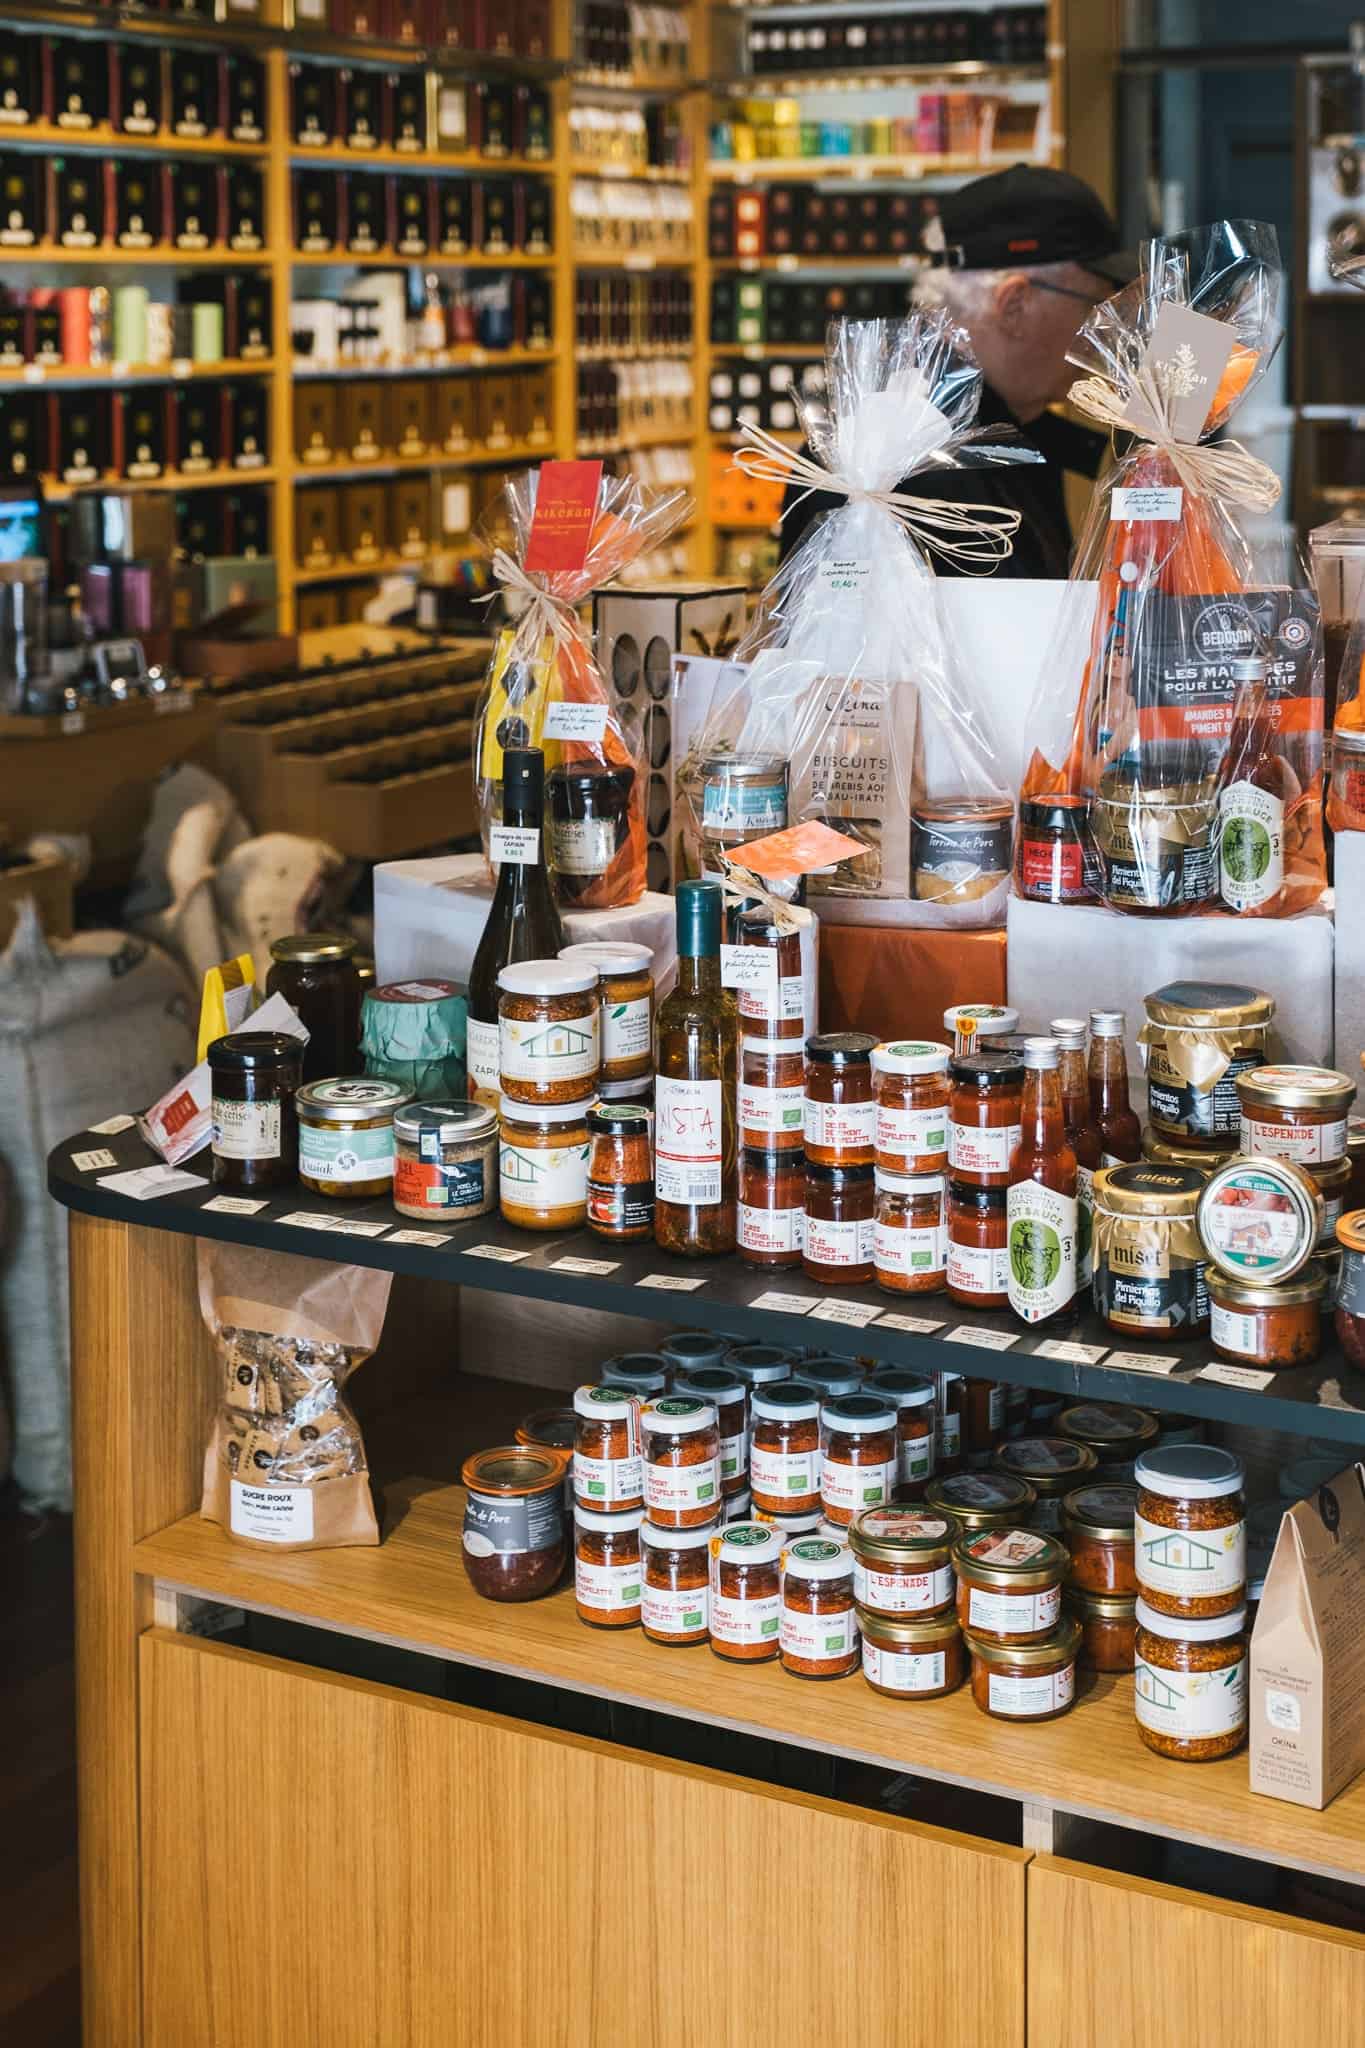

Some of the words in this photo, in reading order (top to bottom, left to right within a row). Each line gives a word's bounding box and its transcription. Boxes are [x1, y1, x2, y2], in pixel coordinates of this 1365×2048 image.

[1164, 668, 1198, 680] LES
[1204, 661, 1296, 679] MAGES
[1165, 681, 1209, 693] POUR
[1212, 675, 1297, 690] L'AITIF
[1184, 708, 1225, 722] AMANDES
[814, 756, 888, 769] BISCUITS
[828, 782, 863, 791] REBIS
[1024, 1206, 1063, 1226] SAUCE
[1115, 1293, 1127, 1304] del
[1128, 1295, 1161, 1308] Piquillo
[242, 1489, 265, 1501] SUCRE
[267, 1494, 292, 1502] ROUX
